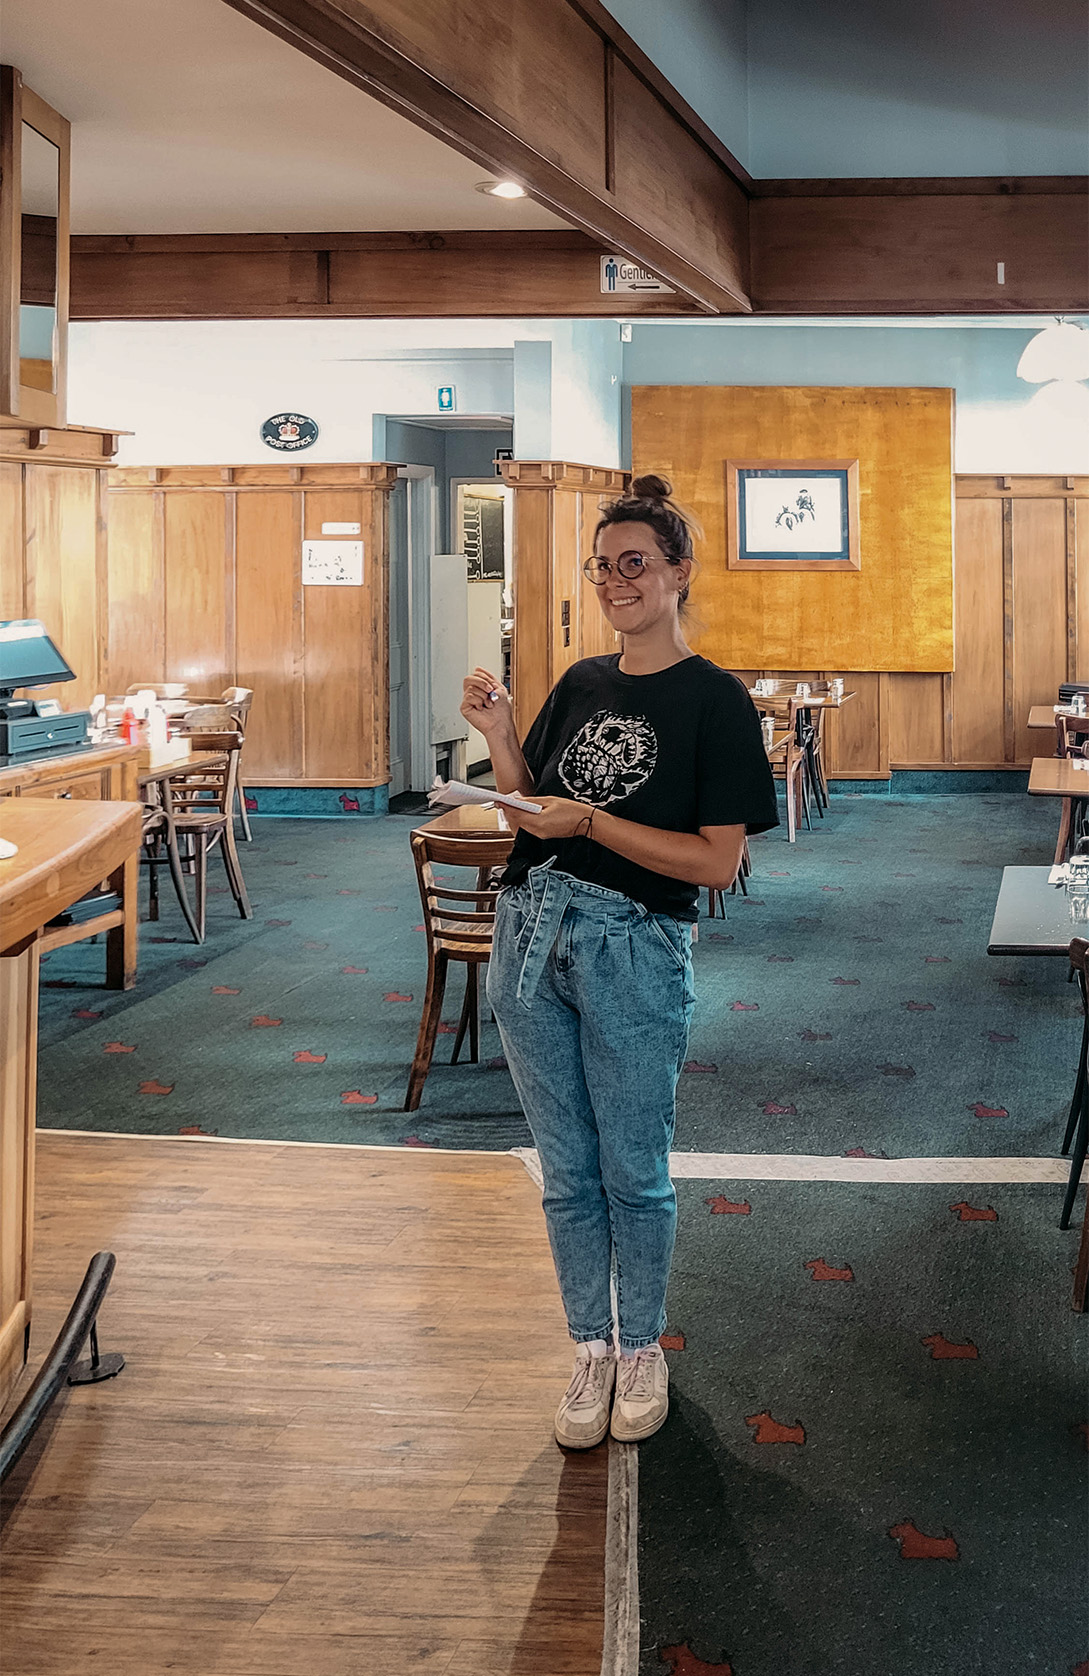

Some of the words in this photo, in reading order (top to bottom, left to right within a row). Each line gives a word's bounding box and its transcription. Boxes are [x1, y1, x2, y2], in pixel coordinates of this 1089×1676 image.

[620, 263, 655, 280] Gentle
[271, 416, 286, 425] THE
[289, 415, 305, 425] OLD
[265, 435, 287, 449] POST
[286, 435, 313, 449] OFFICE
